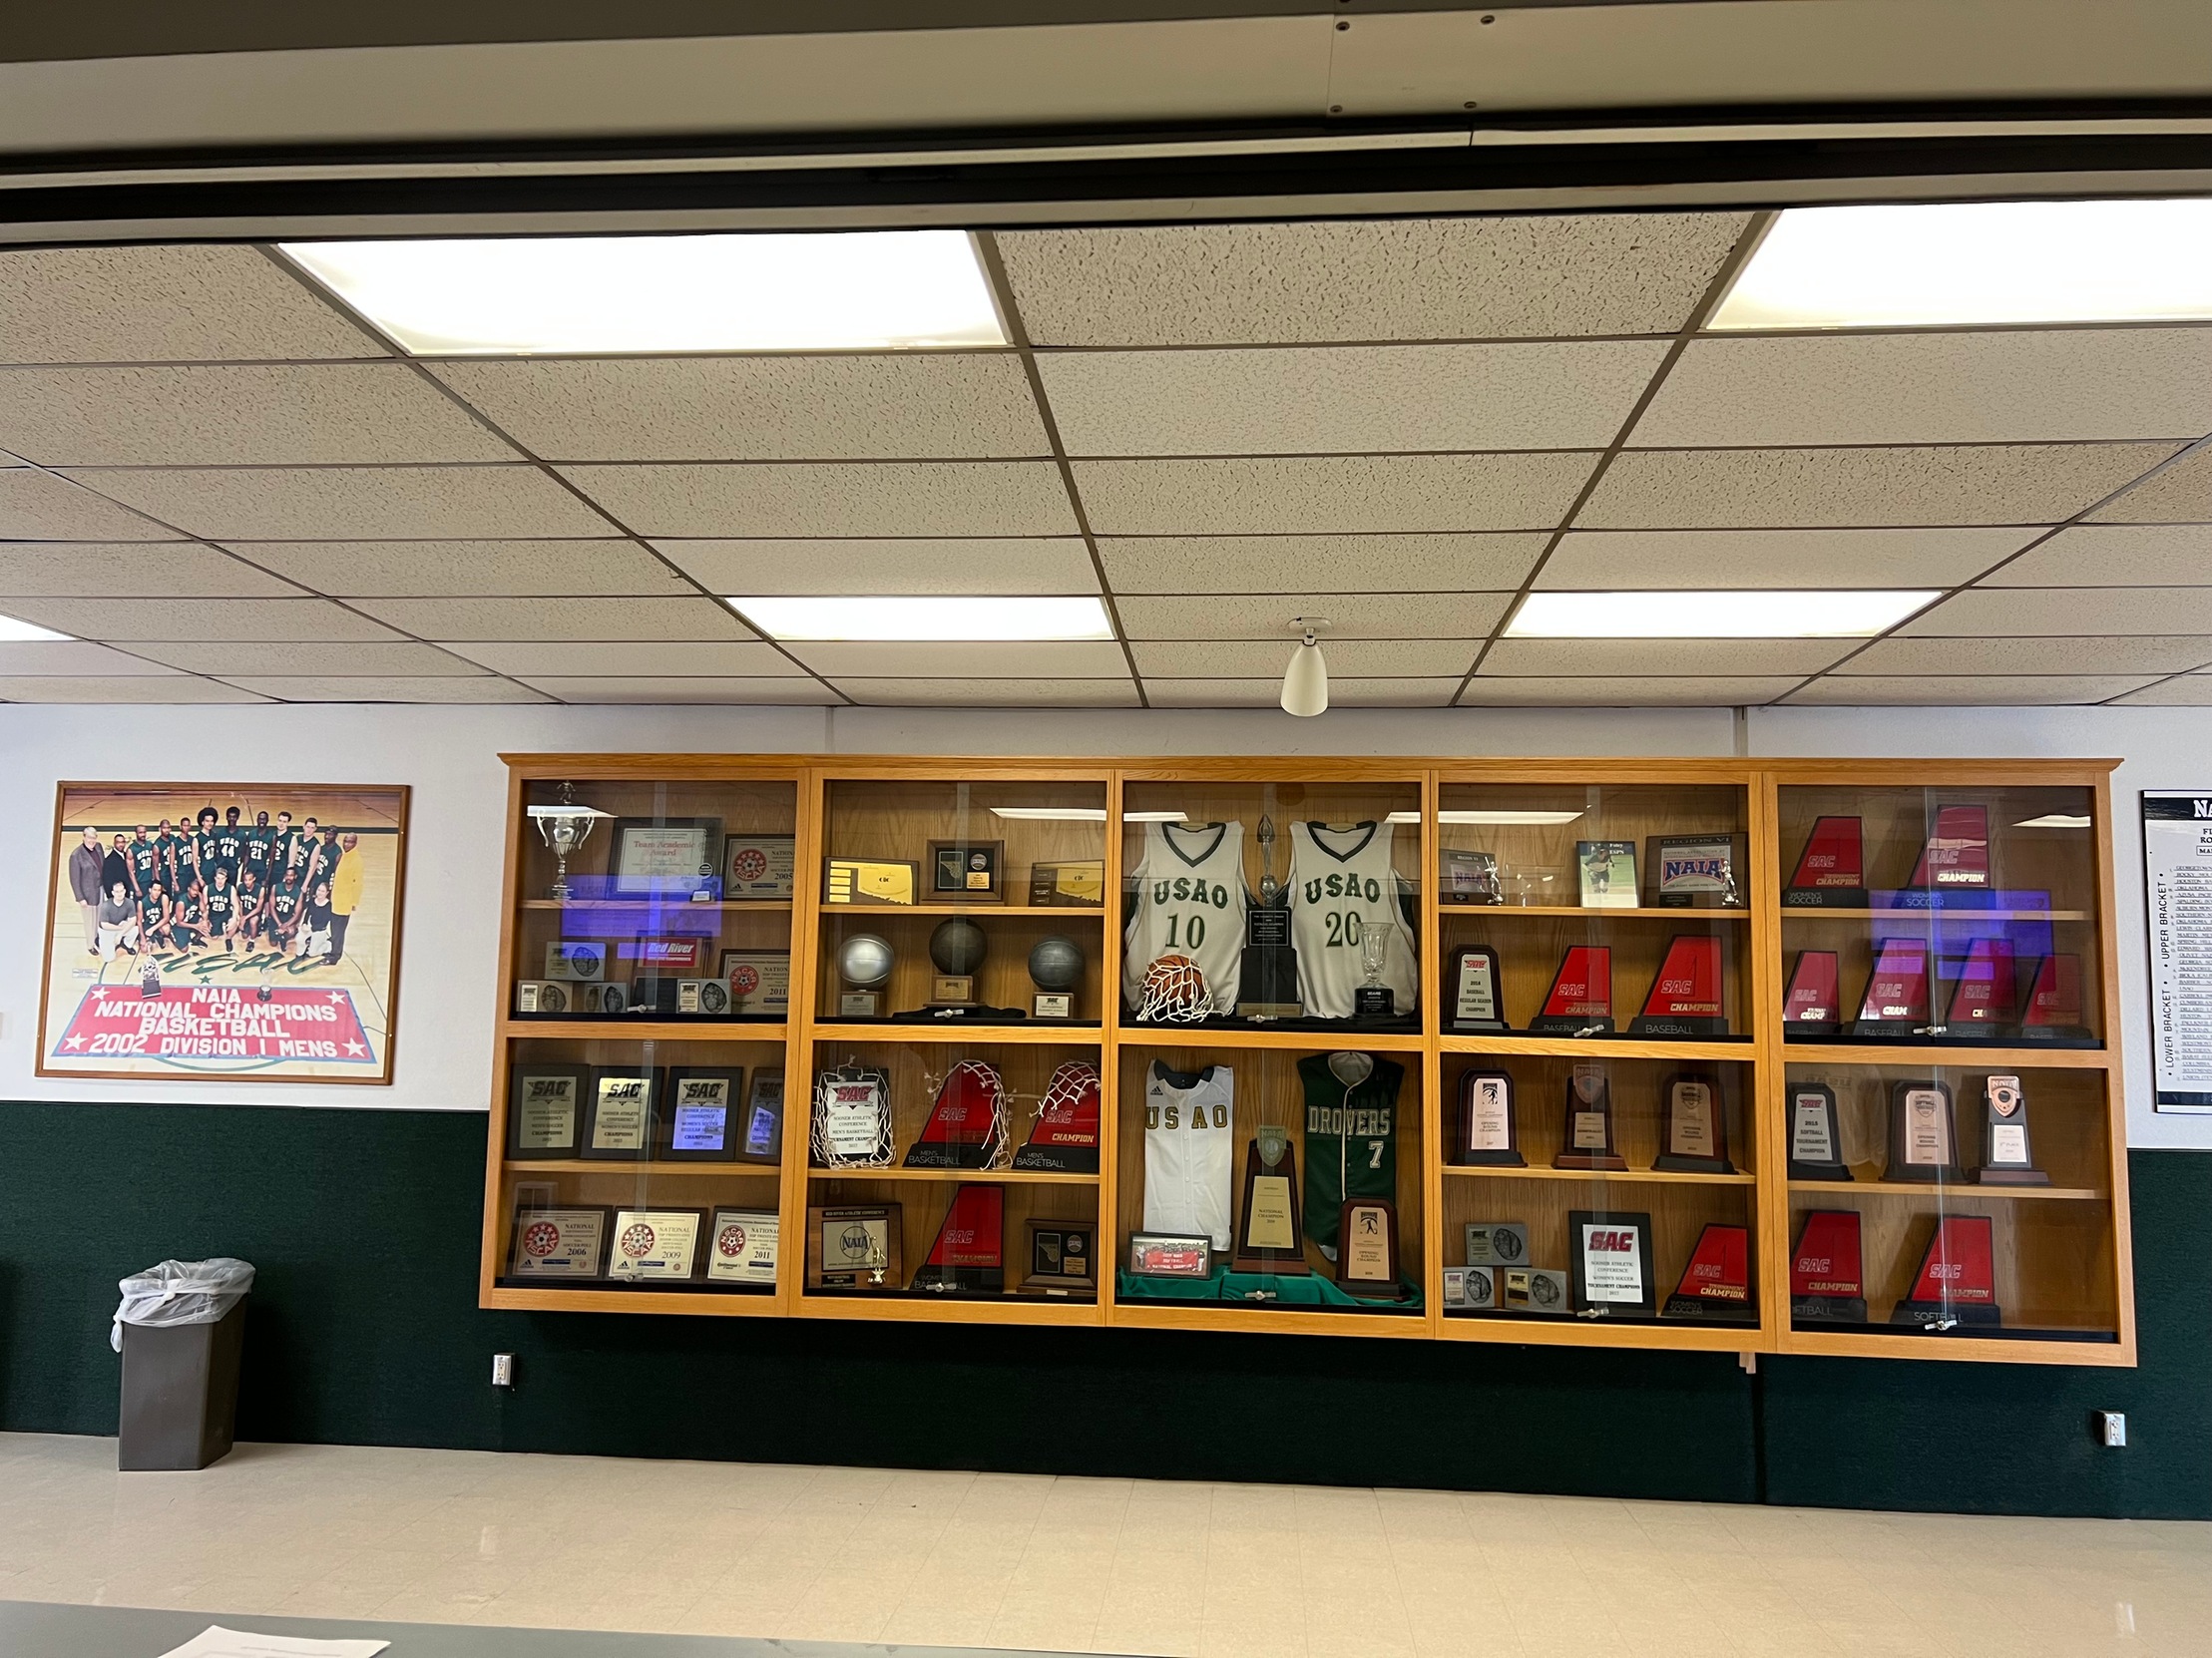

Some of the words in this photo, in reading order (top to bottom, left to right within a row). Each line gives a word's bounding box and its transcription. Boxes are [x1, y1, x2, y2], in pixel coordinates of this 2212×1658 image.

[221, 845, 234, 857] 44
[250, 848, 261, 860] 21
[1929, 850, 1959, 864] SAC
[140, 858, 152, 870] 30
[1808, 856, 1836, 868] SAC
[1664, 860, 1724, 881] NAIA
[1455, 871, 1483, 885] NAIA
[1938, 874, 1985, 883] CHAMPION
[1154, 877, 1228, 909] USAO
[1305, 873, 1381, 905] USAO
[213, 902, 224, 912] 20
[244, 900, 251, 910] 11
[276, 902, 288, 913] 34
[2158, 882, 2168, 925] BRACKET
[1165, 913, 1205, 949] 10
[1325, 911, 1361, 948] 20
[648, 943, 668, 953] Red
[666, 943, 694, 953] River
[2160, 930, 2170, 960] UPPER
[1558, 984, 1585, 997] SAC
[1661, 980, 1692, 995] SAC
[1876, 983, 1902, 998] SAC
[1965, 986, 1991, 999] SAC
[192, 988, 241, 1004] NAIA
[1795, 990, 1817, 1002] SAC
[94, 1002, 196, 1020] NATIONAL
[211, 1003, 337, 1022] CHAMPIONS
[2162, 990, 2172, 1032] BRACKET
[138, 1018, 289, 1037] BASKETBALL
[1646, 1025, 1693, 1035] BASEBALL
[88, 1033, 150, 1053] 2002
[160, 1037, 246, 1055] DIVISION
[278, 1039, 337, 1057] MENS
[2164, 1036, 2174, 1067] LOWER
[531, 1080, 570, 1096] SAC
[606, 1083, 641, 1097] SAC
[686, 1082, 720, 1096] SAC
[1991, 1079, 2017, 1088] NAIA
[836, 1085, 872, 1101] SAC
[1802, 1099, 1822, 1108] SAC
[939, 1108, 967, 1121] SAC
[1046, 1110, 1073, 1123] SAC
[1307, 1105, 1391, 1135] DROVERS
[1052, 1133, 1094, 1143] CHAMPION
[909, 1155, 961, 1165] BASKETBALL
[1369, 1141, 1384, 1168] 7
[1017, 1158, 1066, 1168] BASKETBALL
[843, 1236, 868, 1250] NAIA
[944, 1230, 974, 1244] SAC
[1588, 1231, 1634, 1252] SAC
[525, 1239, 557, 1255] NSCAA
[623, 1240, 655, 1256] NSCAA
[1693, 1264, 1721, 1278] SAC
[1798, 1258, 1830, 1273] SAC
[1930, 1264, 1962, 1279] SAC
[1700, 1288, 1745, 1299] CHAMPION
[1808, 1282, 1858, 1292] CHAMPION
[1670, 1306, 1703, 1315] SOCCER
